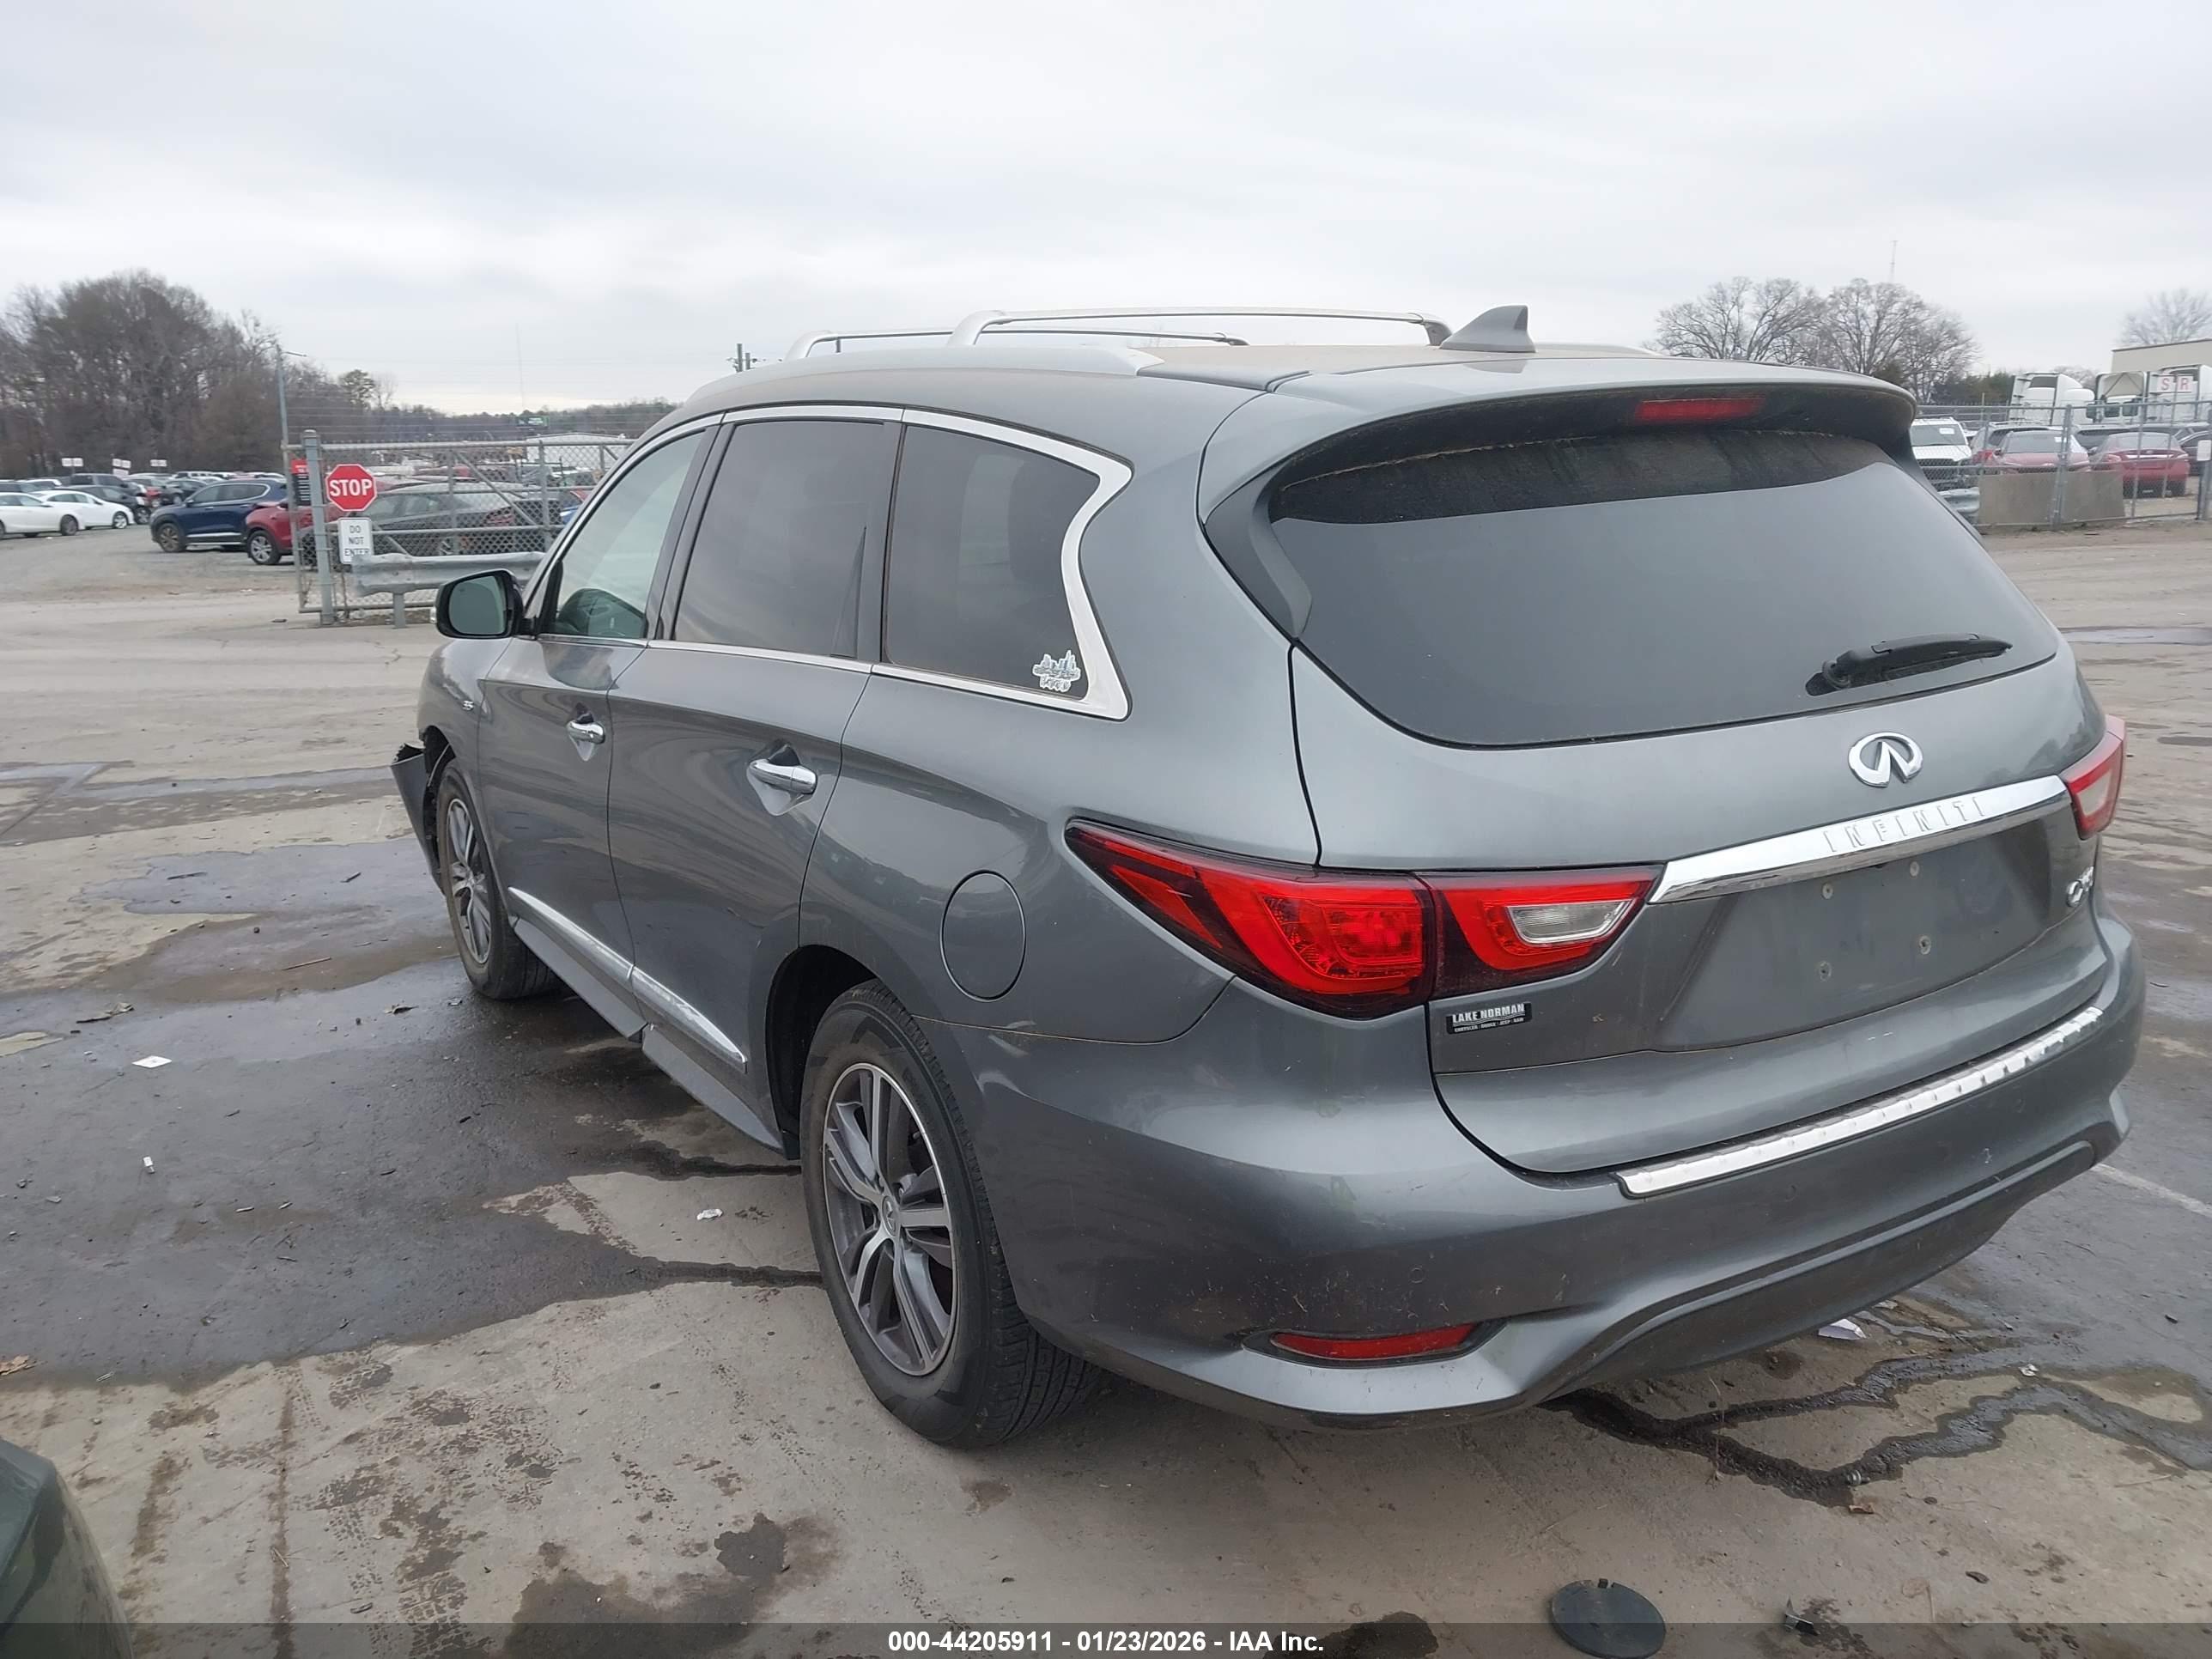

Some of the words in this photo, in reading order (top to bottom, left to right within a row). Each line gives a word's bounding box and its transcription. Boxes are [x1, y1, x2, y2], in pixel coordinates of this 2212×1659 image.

[329, 479, 373, 496] STOP
[349, 525, 362, 533] DO
[349, 536, 365, 545] NOT
[1822, 797, 1985, 853] INFINITI
[1452, 1011, 1478, 1024] LAKE
[1480, 1003, 1525, 1019] NORMAN
